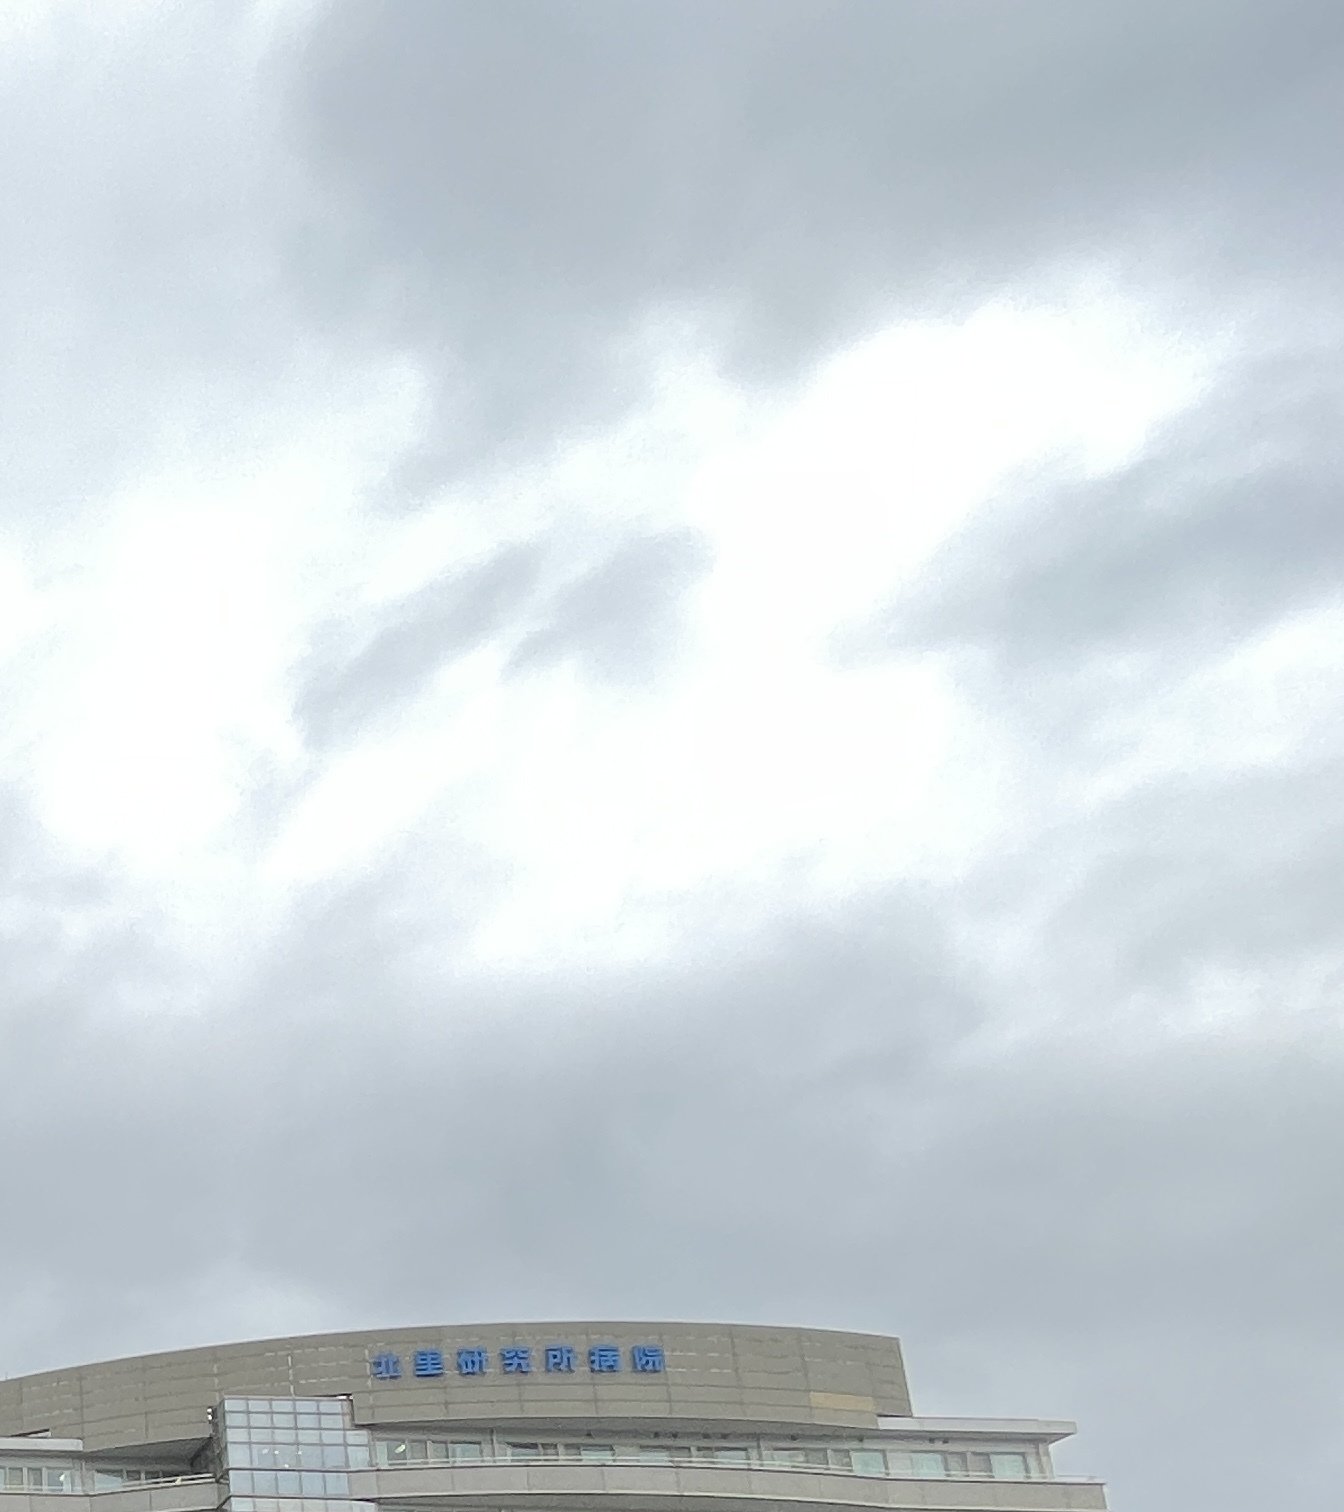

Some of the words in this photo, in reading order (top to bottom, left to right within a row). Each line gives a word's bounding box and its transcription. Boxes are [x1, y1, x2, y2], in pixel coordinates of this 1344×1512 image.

[372, 1345, 666, 1379] 北里研究所病院
